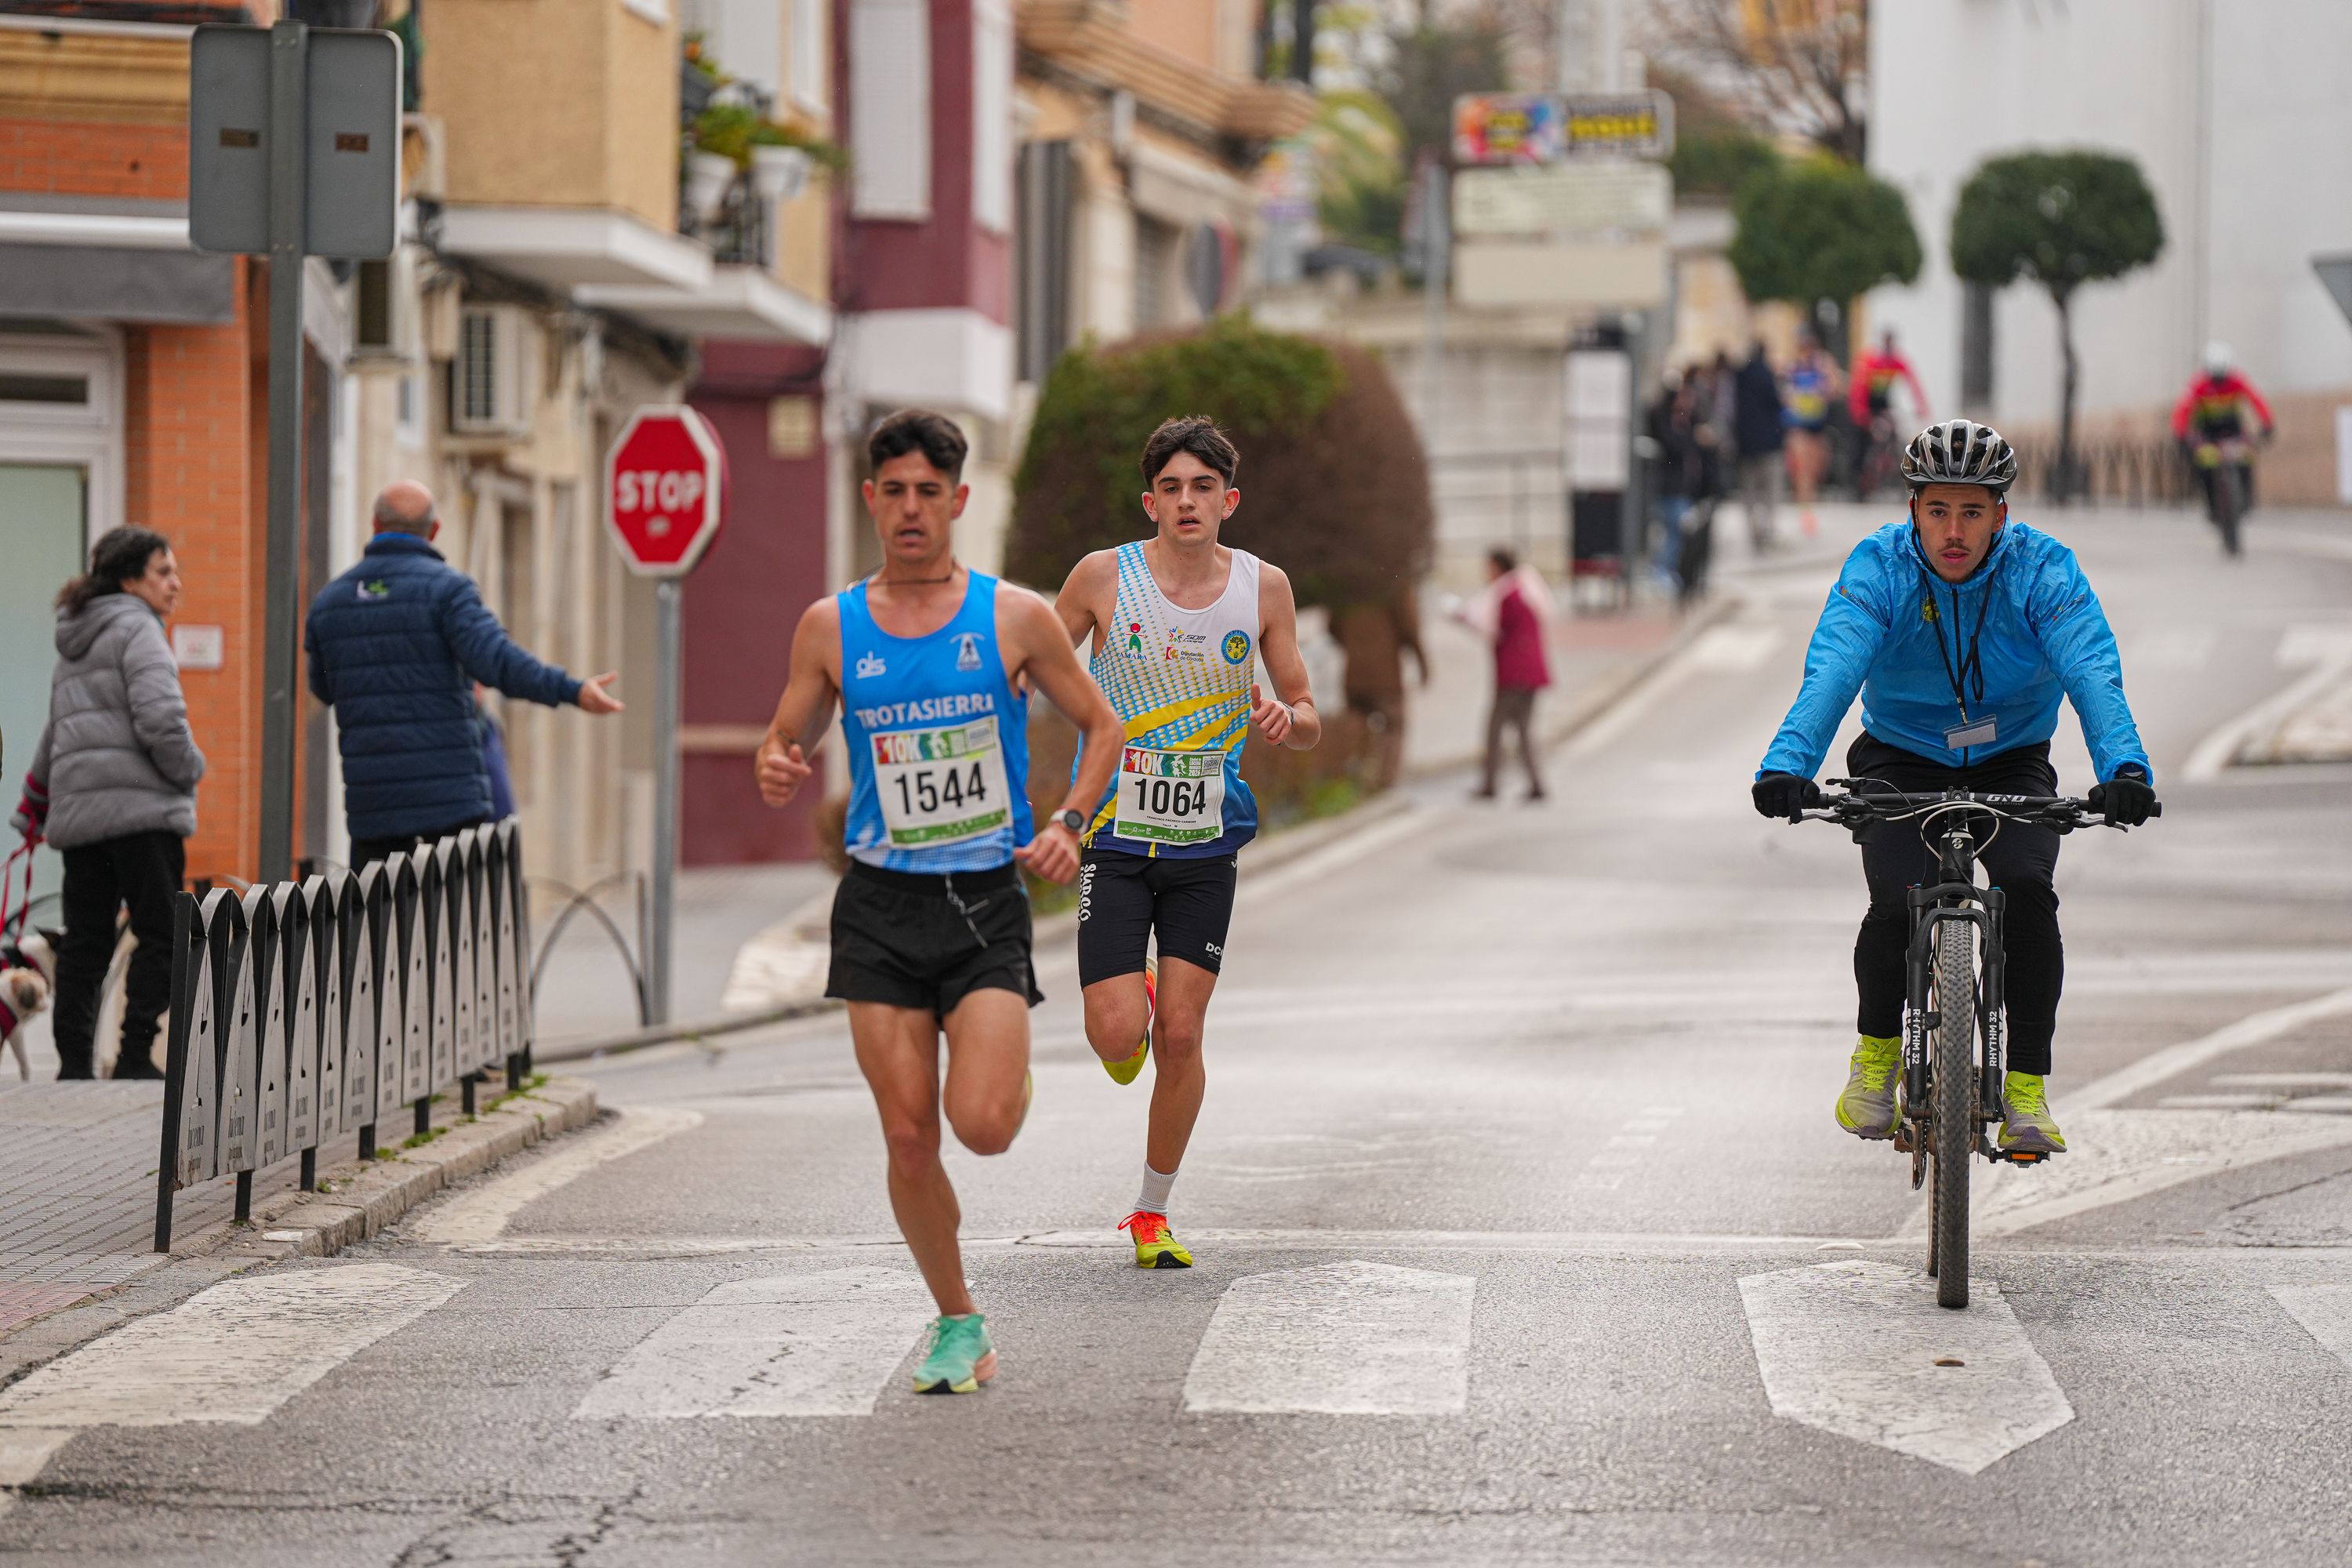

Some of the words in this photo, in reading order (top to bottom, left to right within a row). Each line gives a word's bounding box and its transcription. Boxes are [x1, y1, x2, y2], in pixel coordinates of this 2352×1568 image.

[617, 470, 703, 512] STOP
[1119, 652, 1148, 661] AMARA
[883, 734, 923, 763] 10K
[1130, 751, 1164, 775] 10K
[895, 762, 985, 815] 1544
[1135, 779, 1206, 816] 1064
[1989, 1011, 1998, 1022] 32
[1912, 1053, 1920, 1065] 32
[1989, 1025, 1998, 1067] RHYTHM
